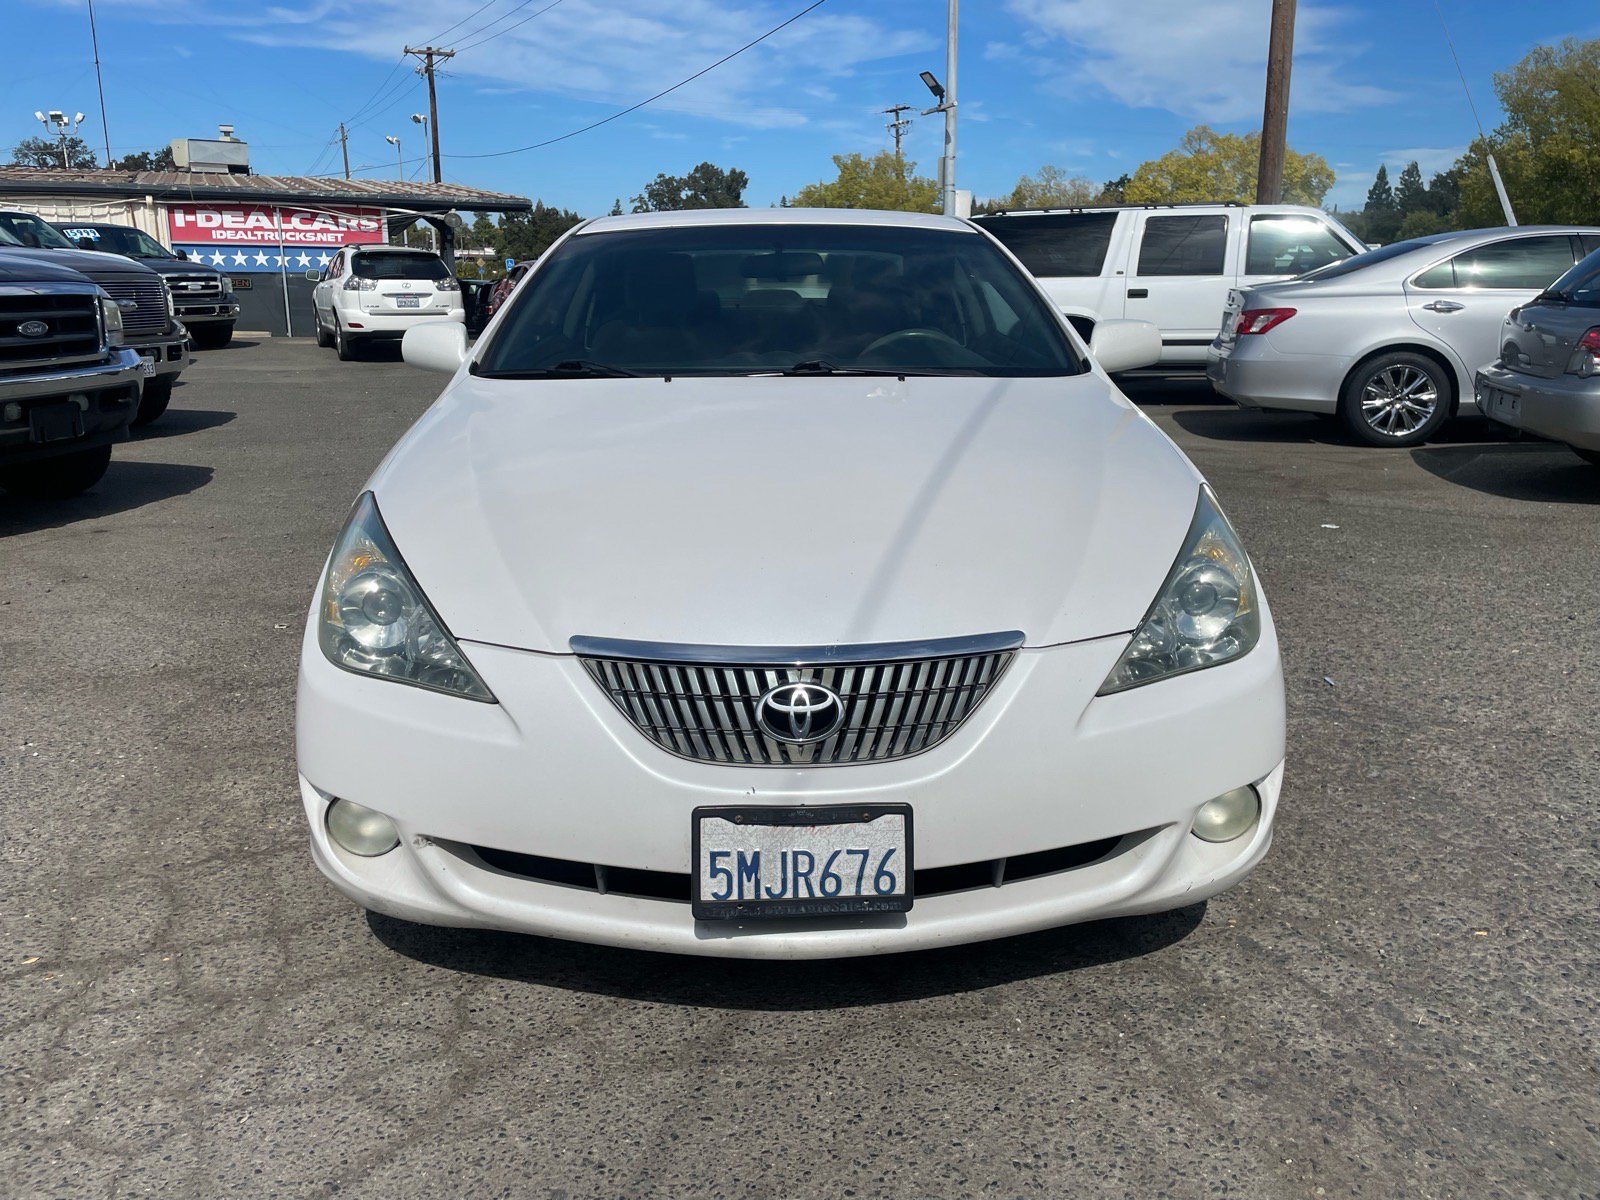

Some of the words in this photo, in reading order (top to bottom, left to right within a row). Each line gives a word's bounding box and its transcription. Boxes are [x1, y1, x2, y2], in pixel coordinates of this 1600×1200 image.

[65, 229, 97, 237] 15999
[231, 279, 249, 287] PEN
[709, 848, 897, 900] 5MJR676
